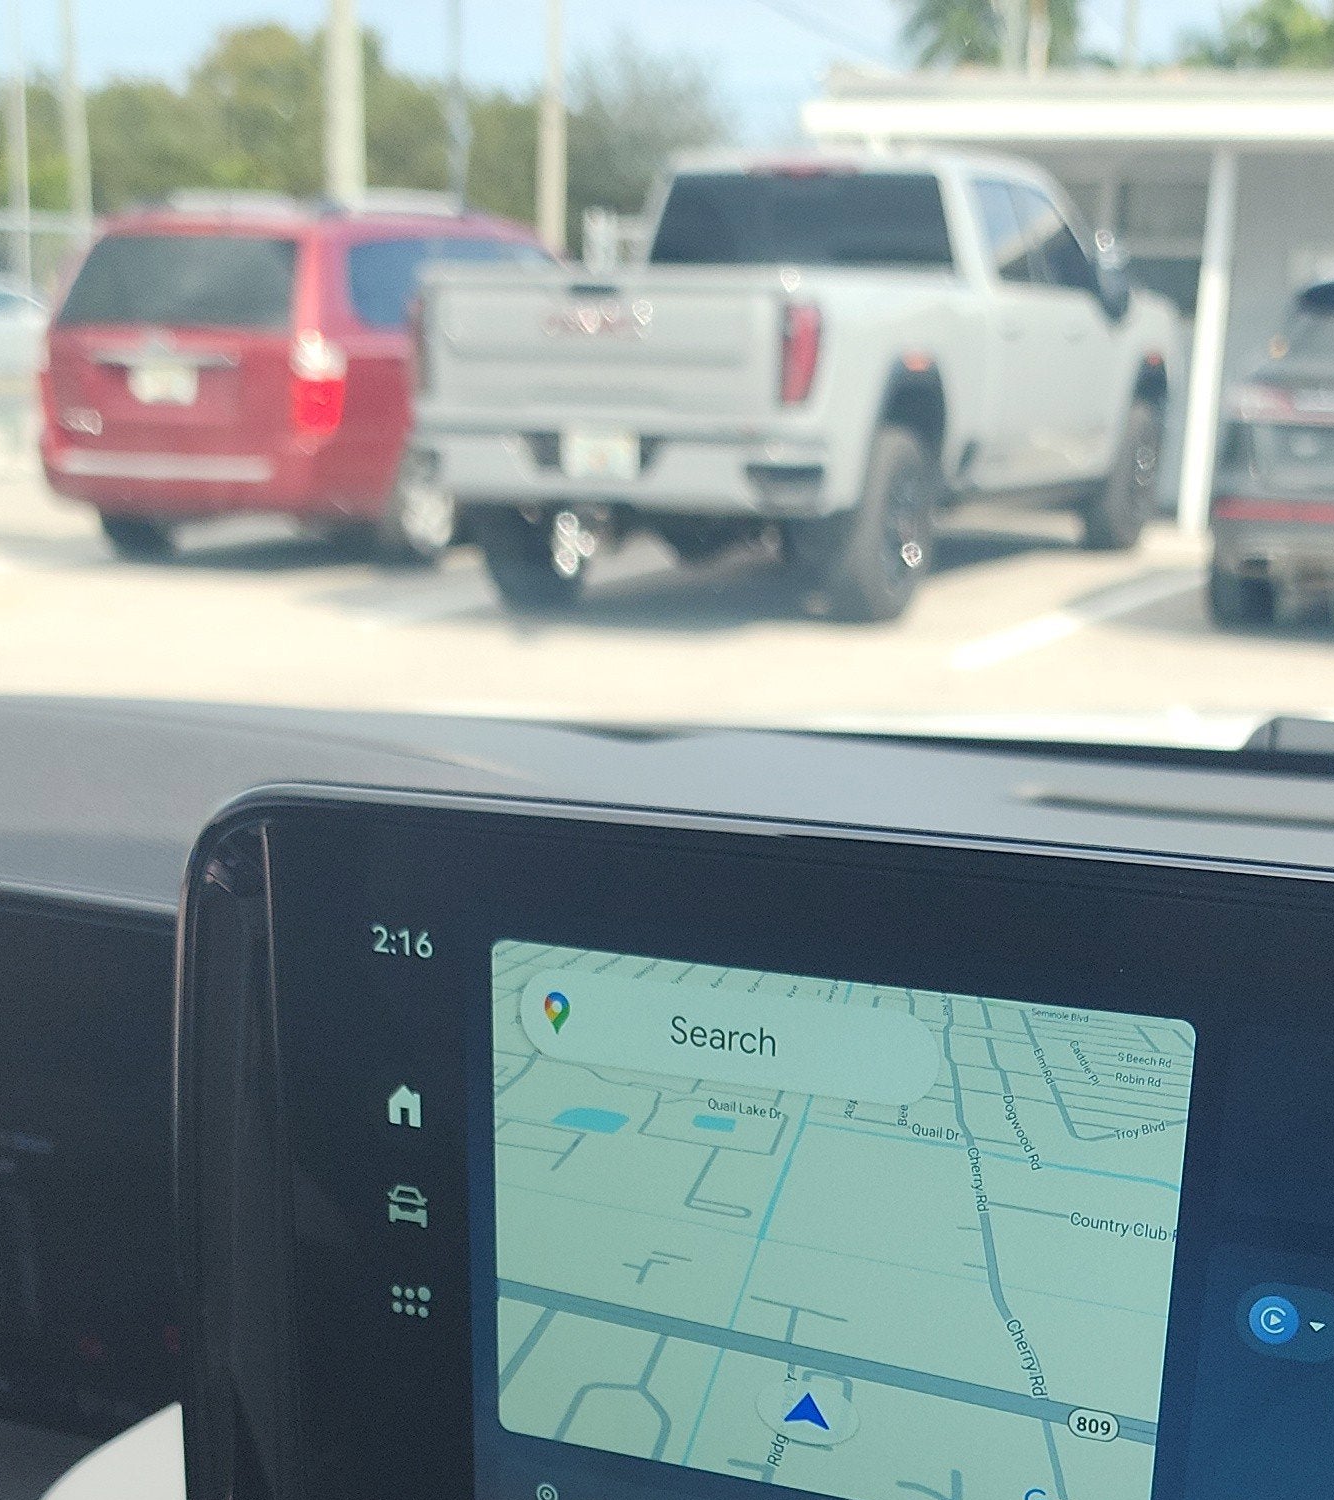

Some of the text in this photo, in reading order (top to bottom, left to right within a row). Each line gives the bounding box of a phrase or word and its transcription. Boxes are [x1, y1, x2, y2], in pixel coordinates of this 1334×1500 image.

[370, 925, 434, 959] 2:16
[1031, 1007, 1089, 1023] Seminole Blvd
[669, 1014, 778, 1057] Search
[1033, 1047, 1055, 1086] Elm Rd
[1069, 1040, 1092, 1075] Caddie
[1117, 1052, 1172, 1069] S Beech Rd
[1115, 1072, 1162, 1088] Robin Rd
[707, 1098, 782, 1120] Quail Lake Dr
[911, 1123, 960, 1141] Quail Dr
[1002, 1095, 1042, 1171] Dogwood Rd
[1114, 1119, 1166, 1142] Troy Blvd
[967, 1146, 989, 1213] Cherry Rd
[1069, 1211, 1129, 1238] Country
[1132, 1222, 1168, 1242] Club
[1006, 1319, 1047, 1398] Cherry Rd
[1076, 1415, 1112, 1437] 809
